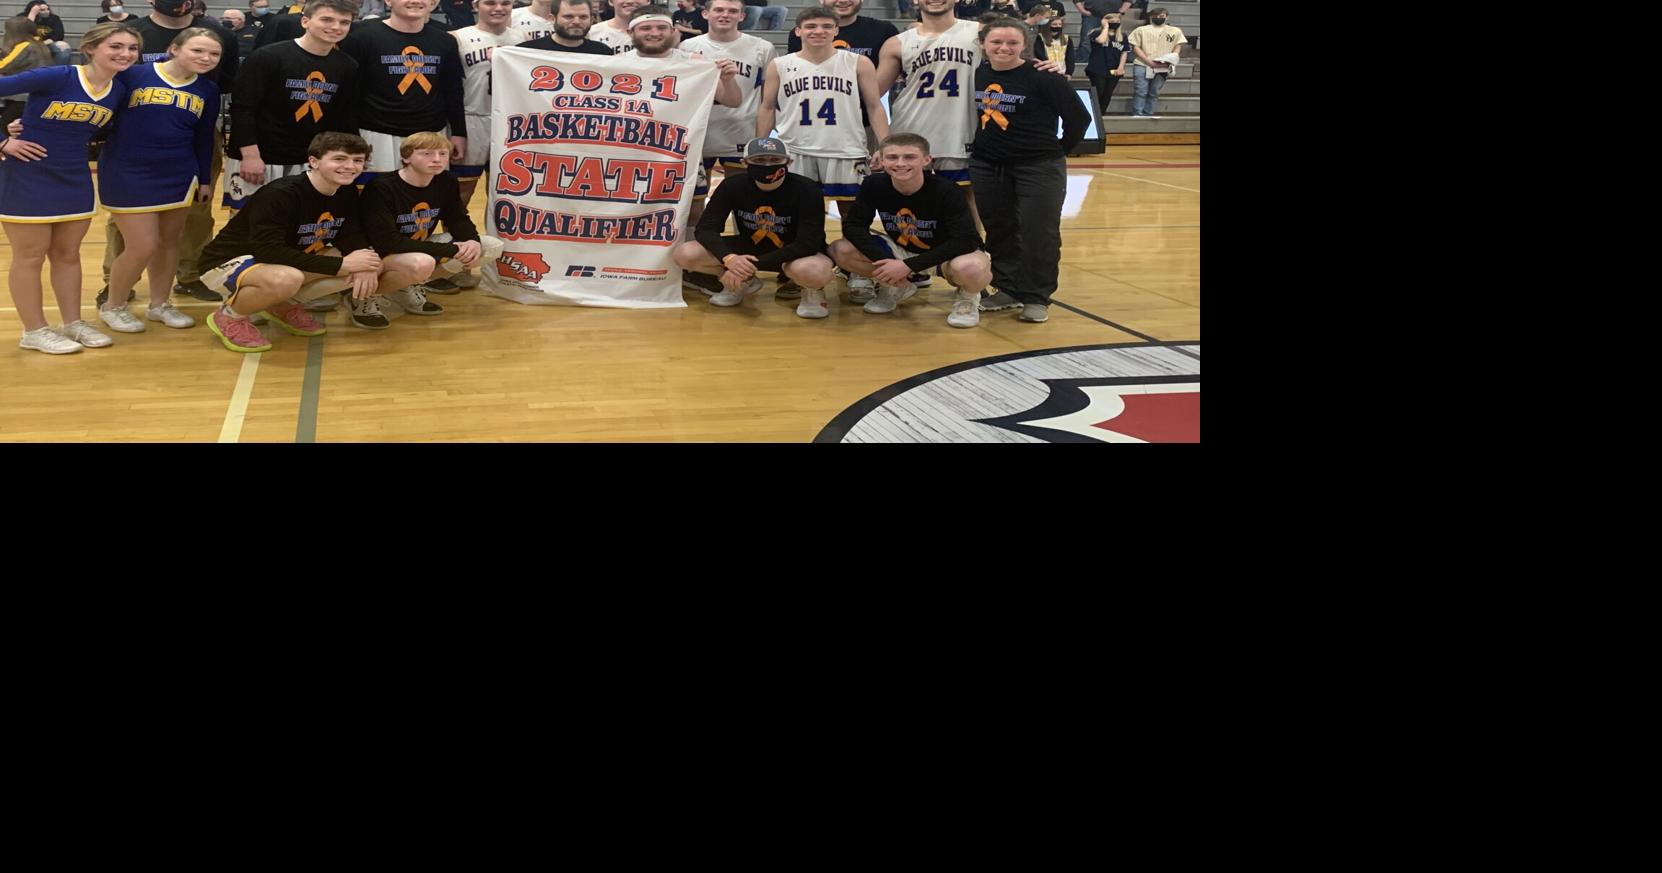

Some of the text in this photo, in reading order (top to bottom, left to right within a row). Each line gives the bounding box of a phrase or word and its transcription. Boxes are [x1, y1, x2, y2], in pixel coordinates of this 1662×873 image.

[465, 46, 493, 67] BLU
[933, 47, 974, 66] DEVILS
[529, 65, 679, 102] 2021
[783, 75, 853, 98] BLUE DEVILS
[916, 69, 959, 99] 24
[553, 94, 653, 116] CLASS 1A
[799, 97, 837, 126] 14
[505, 111, 690, 157] BASKETBALL
[496, 149, 687, 204] STATE
[494, 198, 678, 245] QUALIFIER
